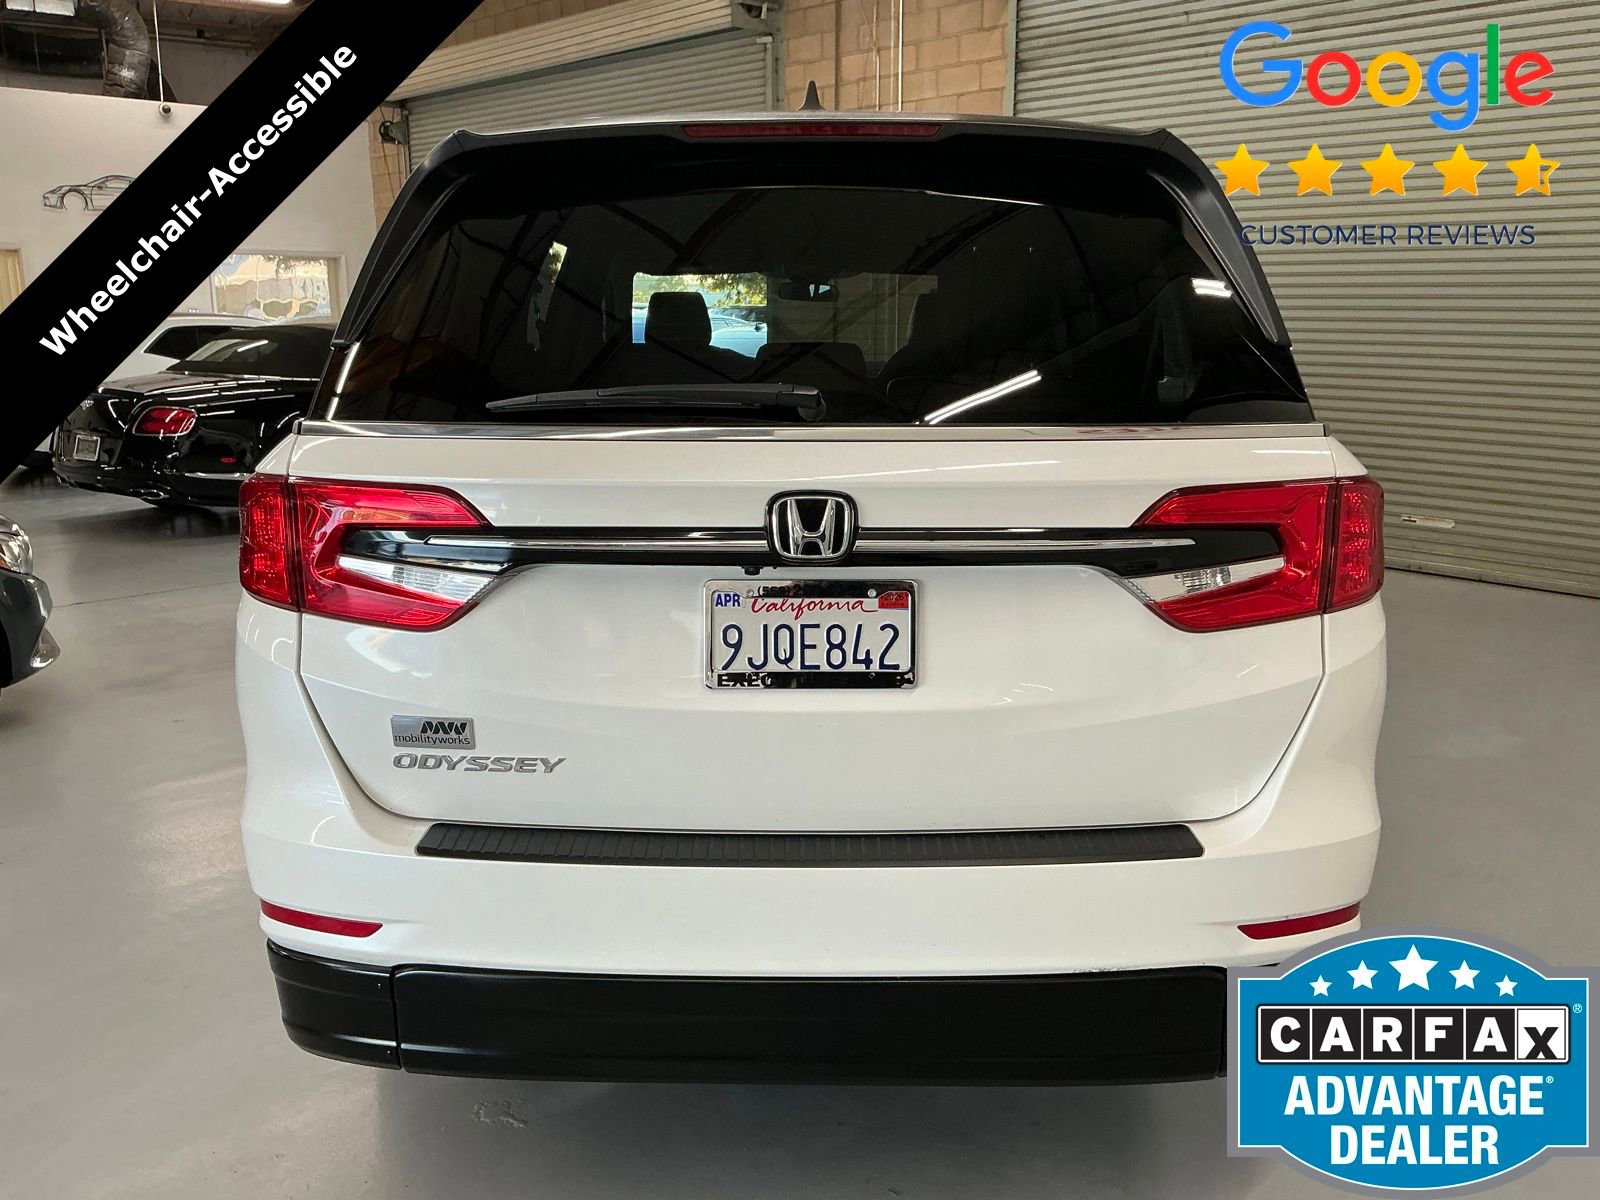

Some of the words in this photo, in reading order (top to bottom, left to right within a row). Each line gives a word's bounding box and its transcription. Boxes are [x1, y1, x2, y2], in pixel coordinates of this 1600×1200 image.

[715, 593, 741, 608] APR
[751, 598, 878, 621] California
[721, 623, 901, 671] 9JQE842
[394, 733, 471, 746] mobilityworks
[392, 752, 567, 774] ODYSSEY
